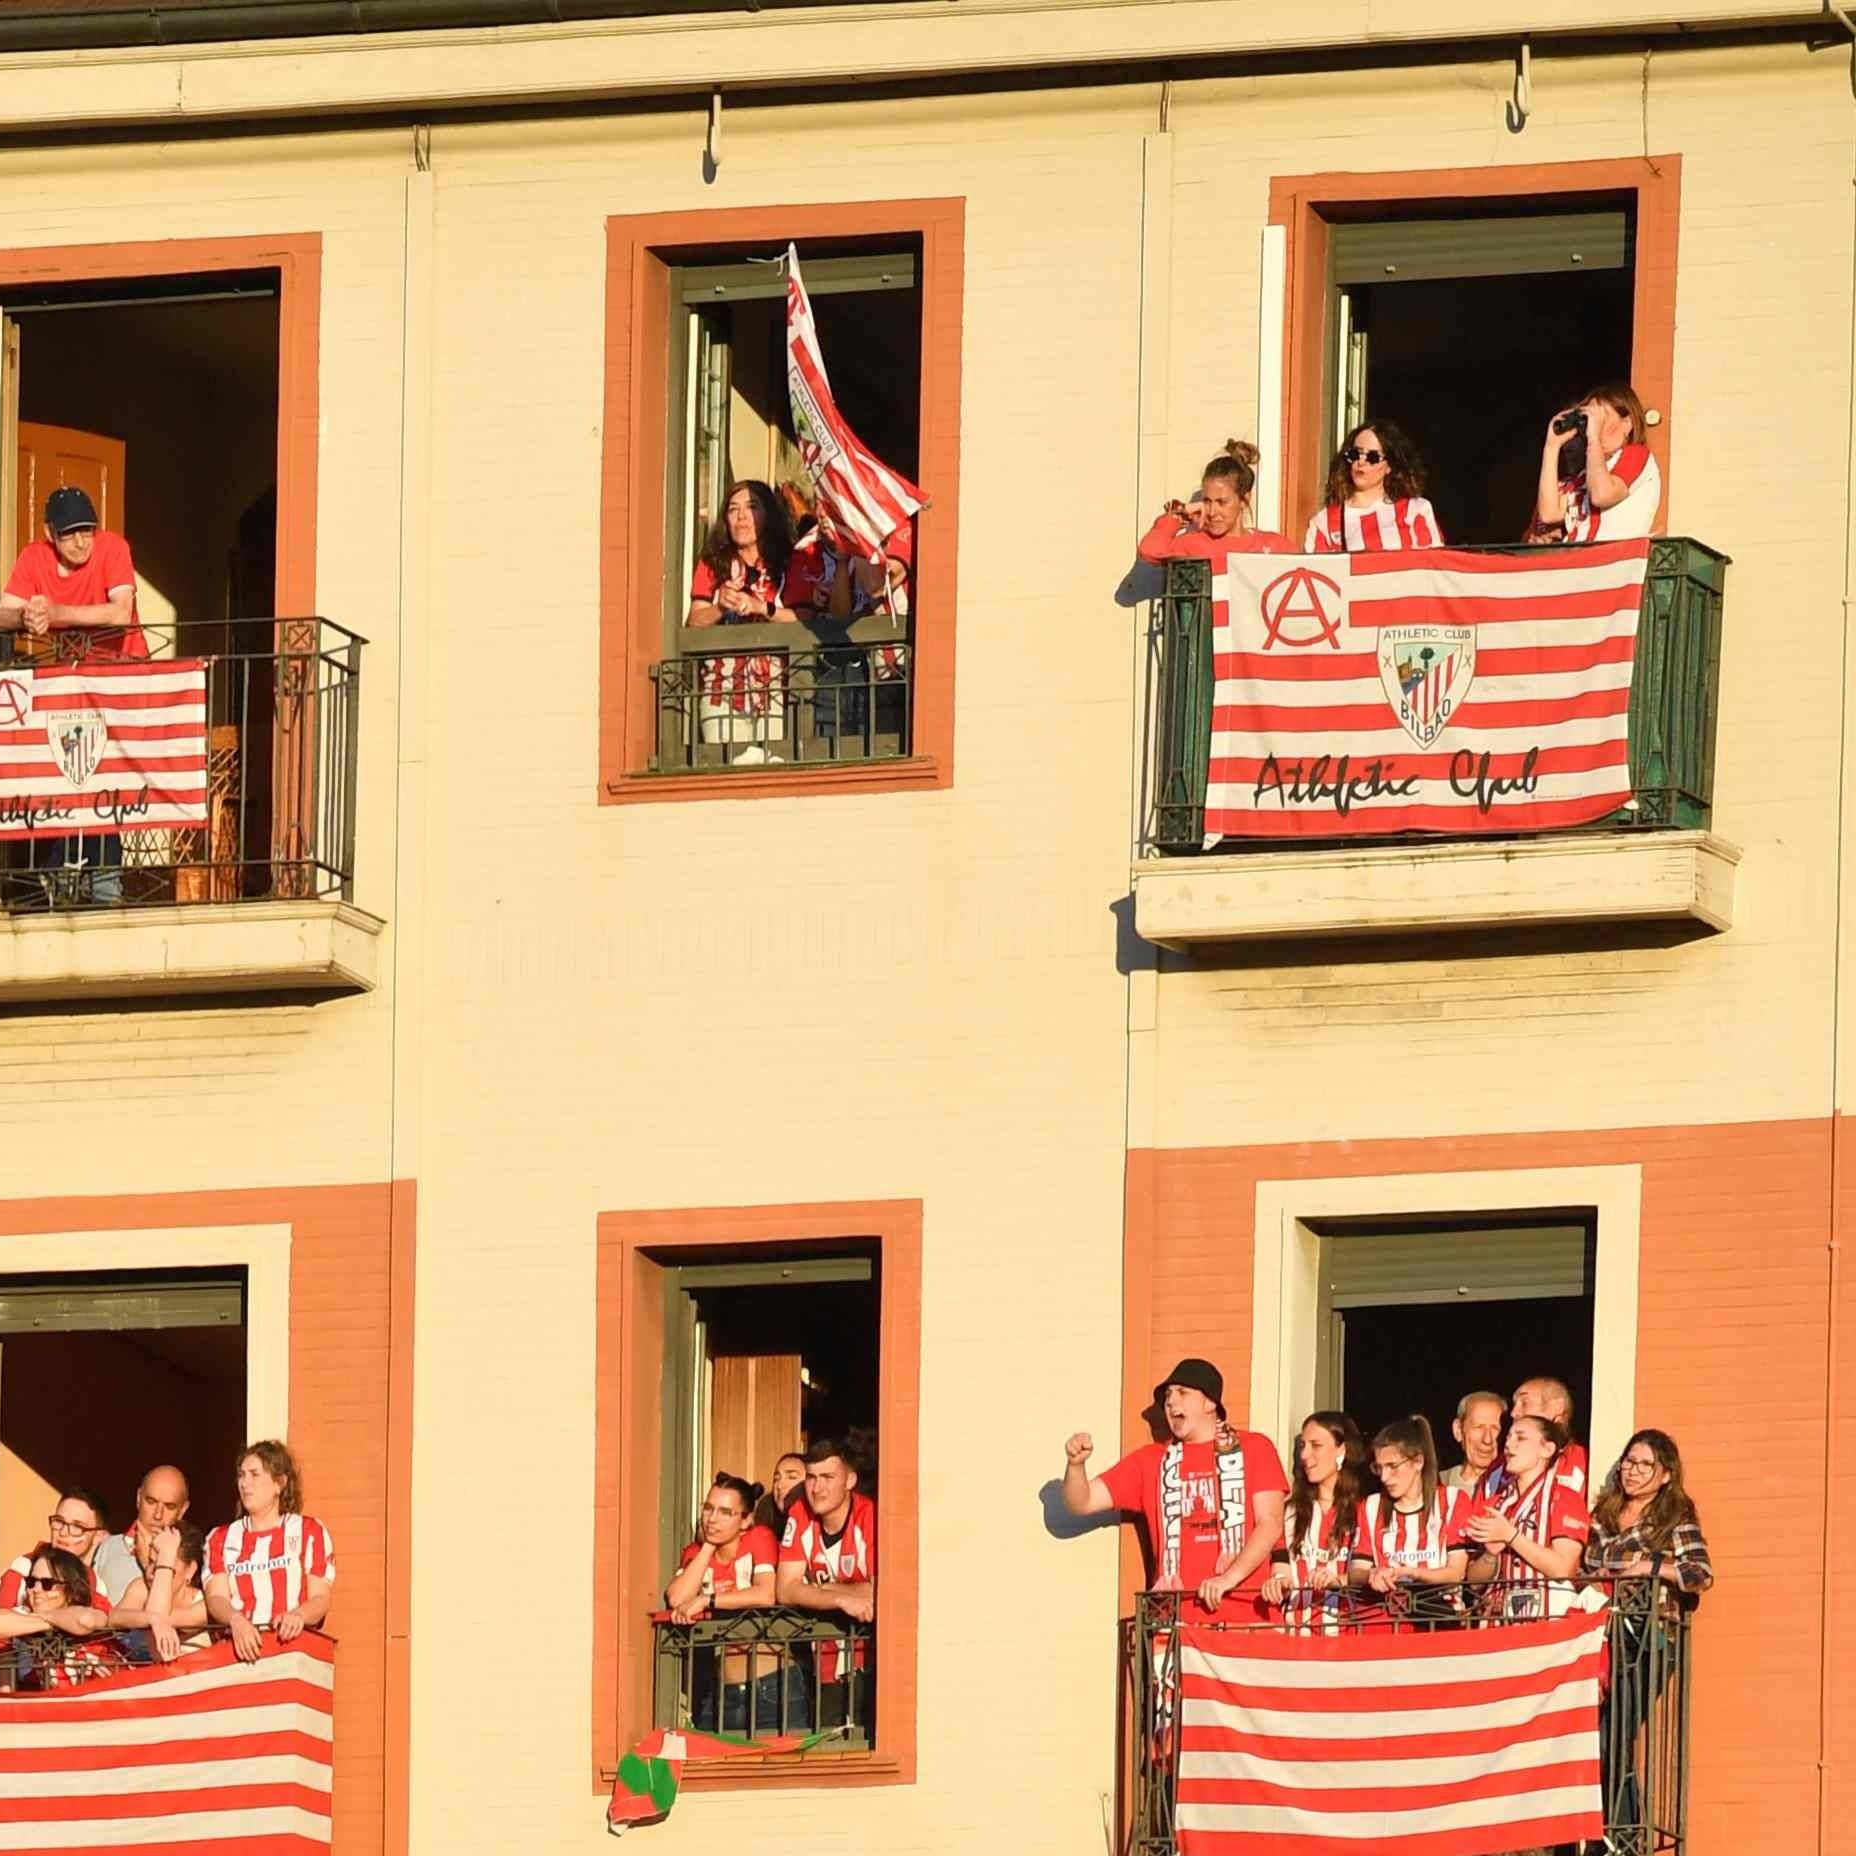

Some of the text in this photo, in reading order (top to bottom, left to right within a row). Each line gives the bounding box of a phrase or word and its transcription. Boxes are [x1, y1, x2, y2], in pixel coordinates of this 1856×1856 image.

[1382, 627, 1472, 641] ATHLETIC CLUB
[1400, 698, 1452, 743] BILBAO
[1253, 745, 1541, 818] Athletic Club
[94, 784, 149, 826] Club
